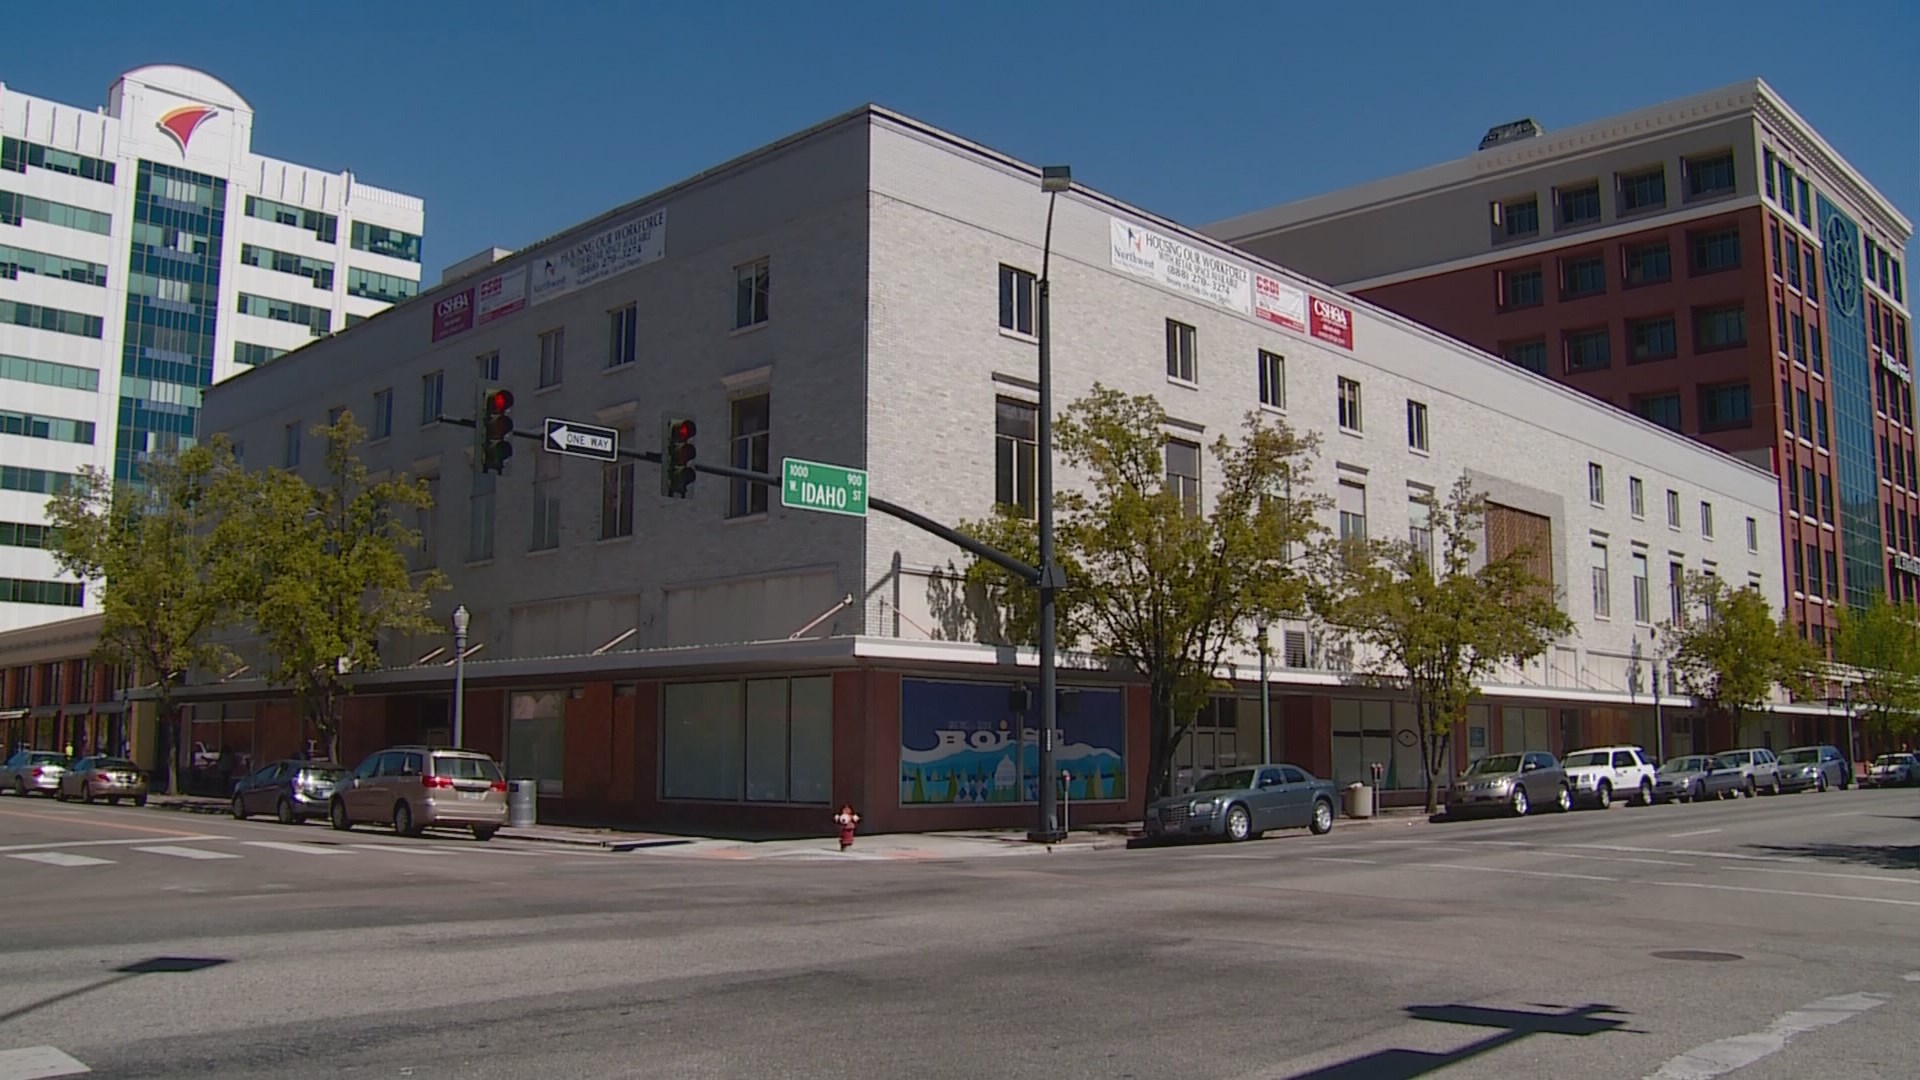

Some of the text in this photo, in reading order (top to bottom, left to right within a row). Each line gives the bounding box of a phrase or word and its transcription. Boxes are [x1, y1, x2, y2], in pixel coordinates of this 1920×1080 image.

[614, 211, 663, 241] WORKFORCE
[1114, 244, 1154, 269] Northwest
[1146, 233, 1247, 282] HOUSING OUR WORKFORCE
[566, 433, 609, 449] ONE WAY
[789, 464, 809, 479] 1000
[847, 473, 863, 487] 900
[801, 481, 847, 509] IDAHO
[852, 490, 862, 502] ST
